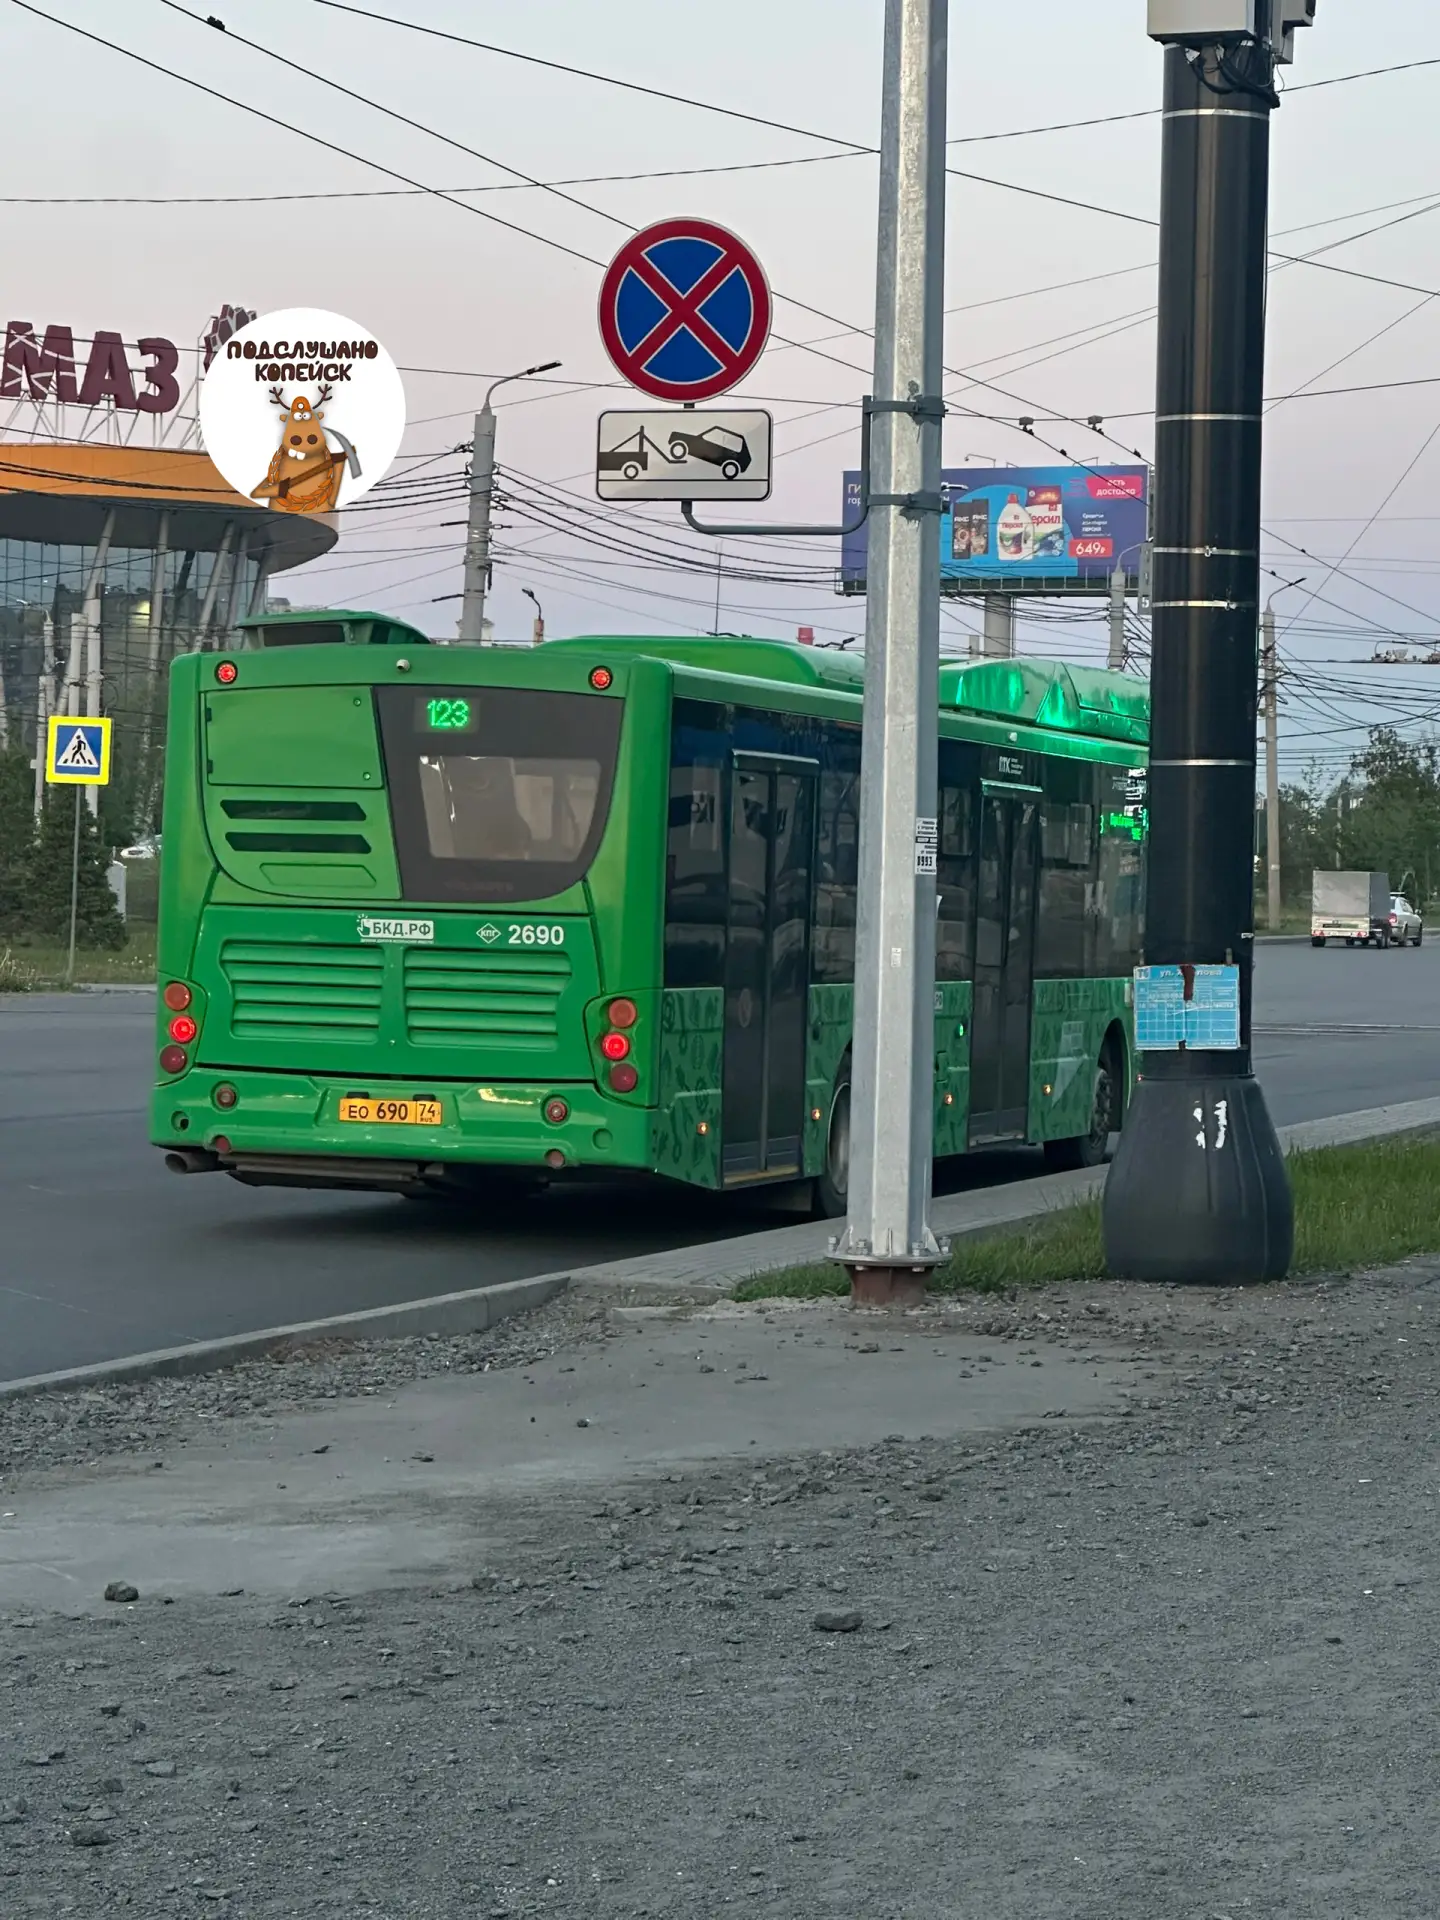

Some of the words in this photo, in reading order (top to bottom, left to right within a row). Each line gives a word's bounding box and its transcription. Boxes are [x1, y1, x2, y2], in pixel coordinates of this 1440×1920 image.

[1096, 487, 1136, 496] доставка
[1031, 514, 1060, 526] ерсил
[427, 699, 469, 728] 123
[373, 922, 431, 936] БКД.РФ
[508, 924, 564, 945] 2690
[376, 1102, 408, 1121] 690
[419, 1103, 436, 1117] 74
